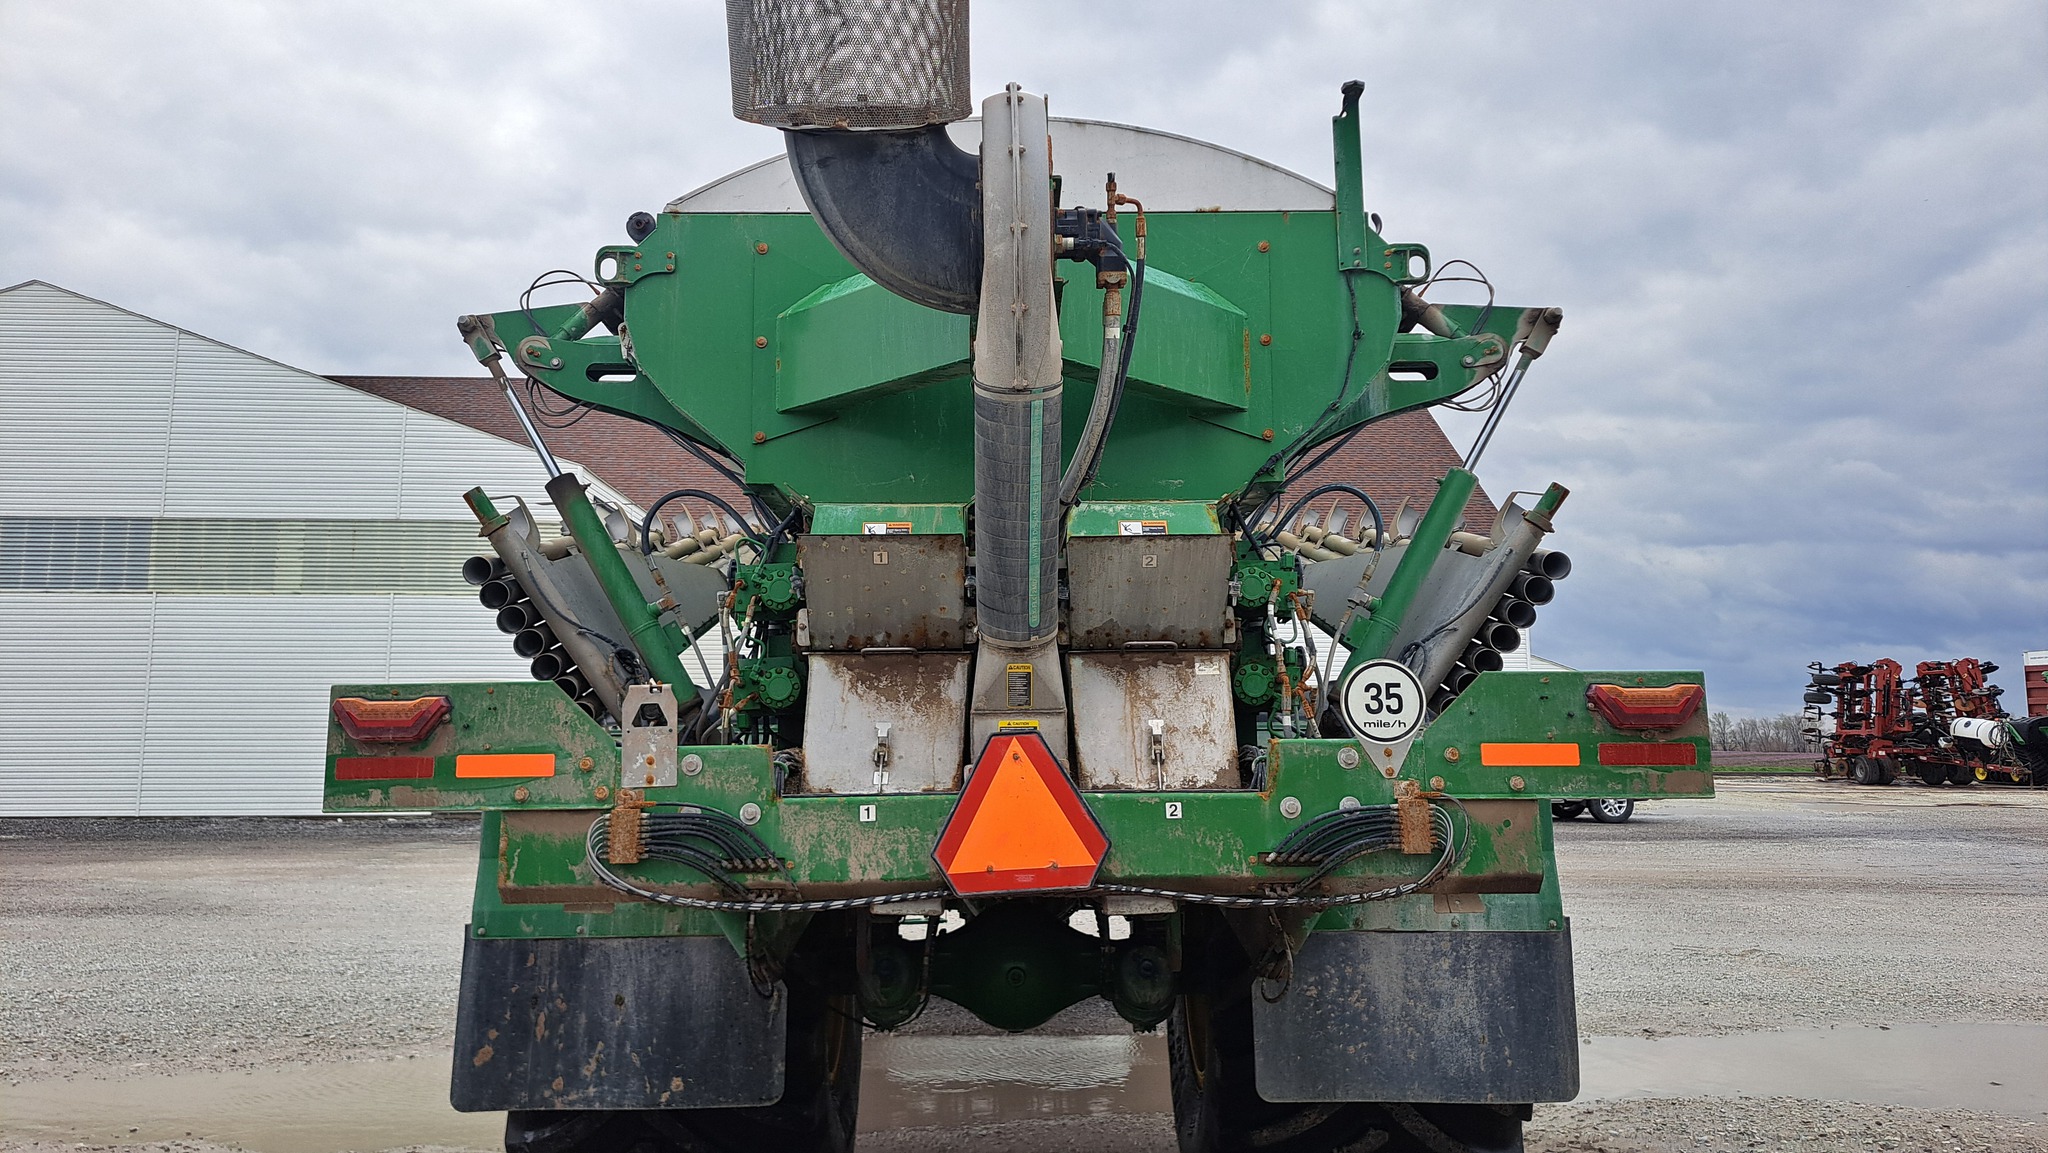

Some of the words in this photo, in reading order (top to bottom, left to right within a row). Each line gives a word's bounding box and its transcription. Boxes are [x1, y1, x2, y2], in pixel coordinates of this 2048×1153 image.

[876, 552, 883, 563] 1
[1145, 556, 1154, 566] 2
[1364, 682, 1404, 715] 35
[1363, 720, 1406, 728] mile/h
[864, 806, 870, 819] 1
[1169, 804, 1178, 816] 2
